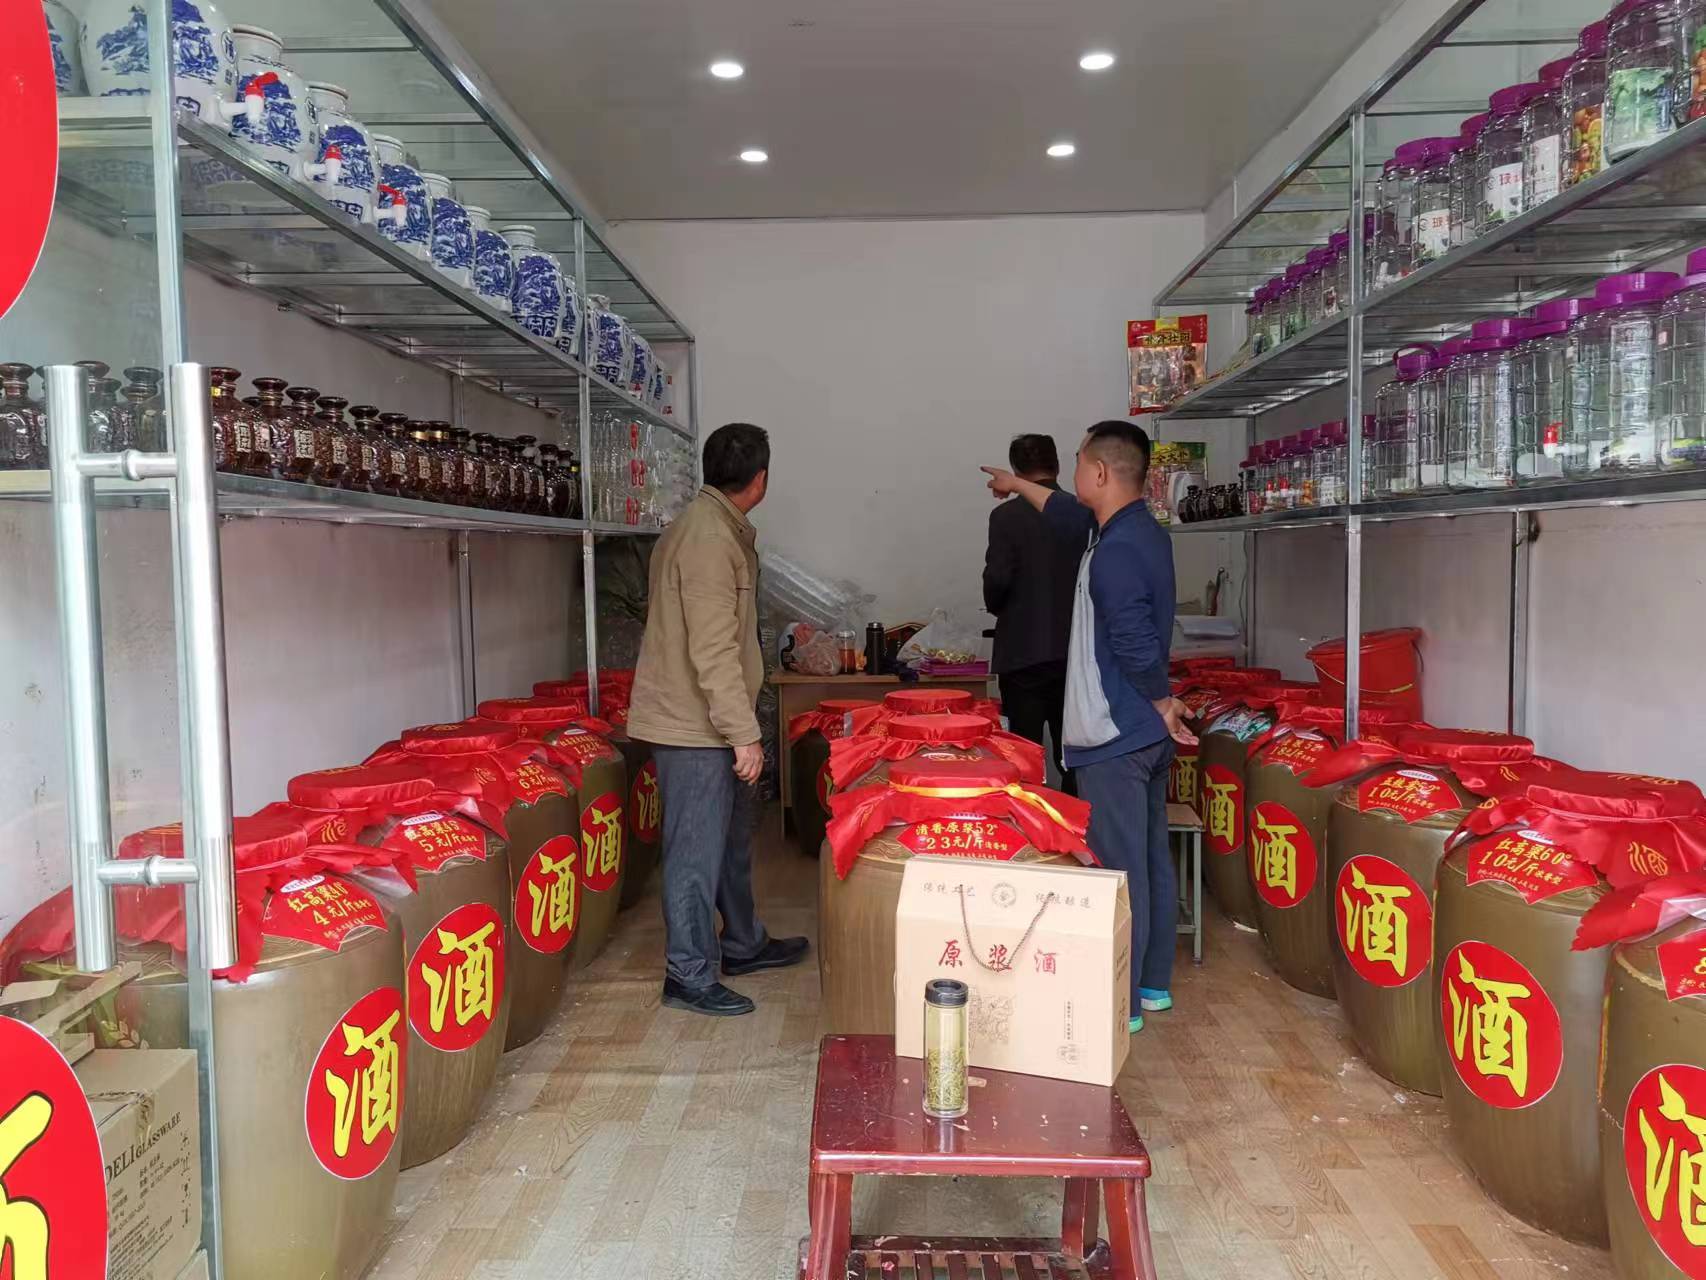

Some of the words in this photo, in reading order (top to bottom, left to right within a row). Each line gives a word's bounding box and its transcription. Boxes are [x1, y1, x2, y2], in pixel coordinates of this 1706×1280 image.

[583, 806, 623, 879] 酒
[1202, 771, 1239, 848] 酒
[1250, 807, 1299, 900] 酒
[528, 850, 577, 938] 酒
[1342, 864, 1410, 978] 酒
[421, 921, 496, 1033] 酒
[938, 938, 1058, 975] 原浆酒
[1448, 949, 1531, 1098] 酒
[325, 1008, 400, 1157] 酒
